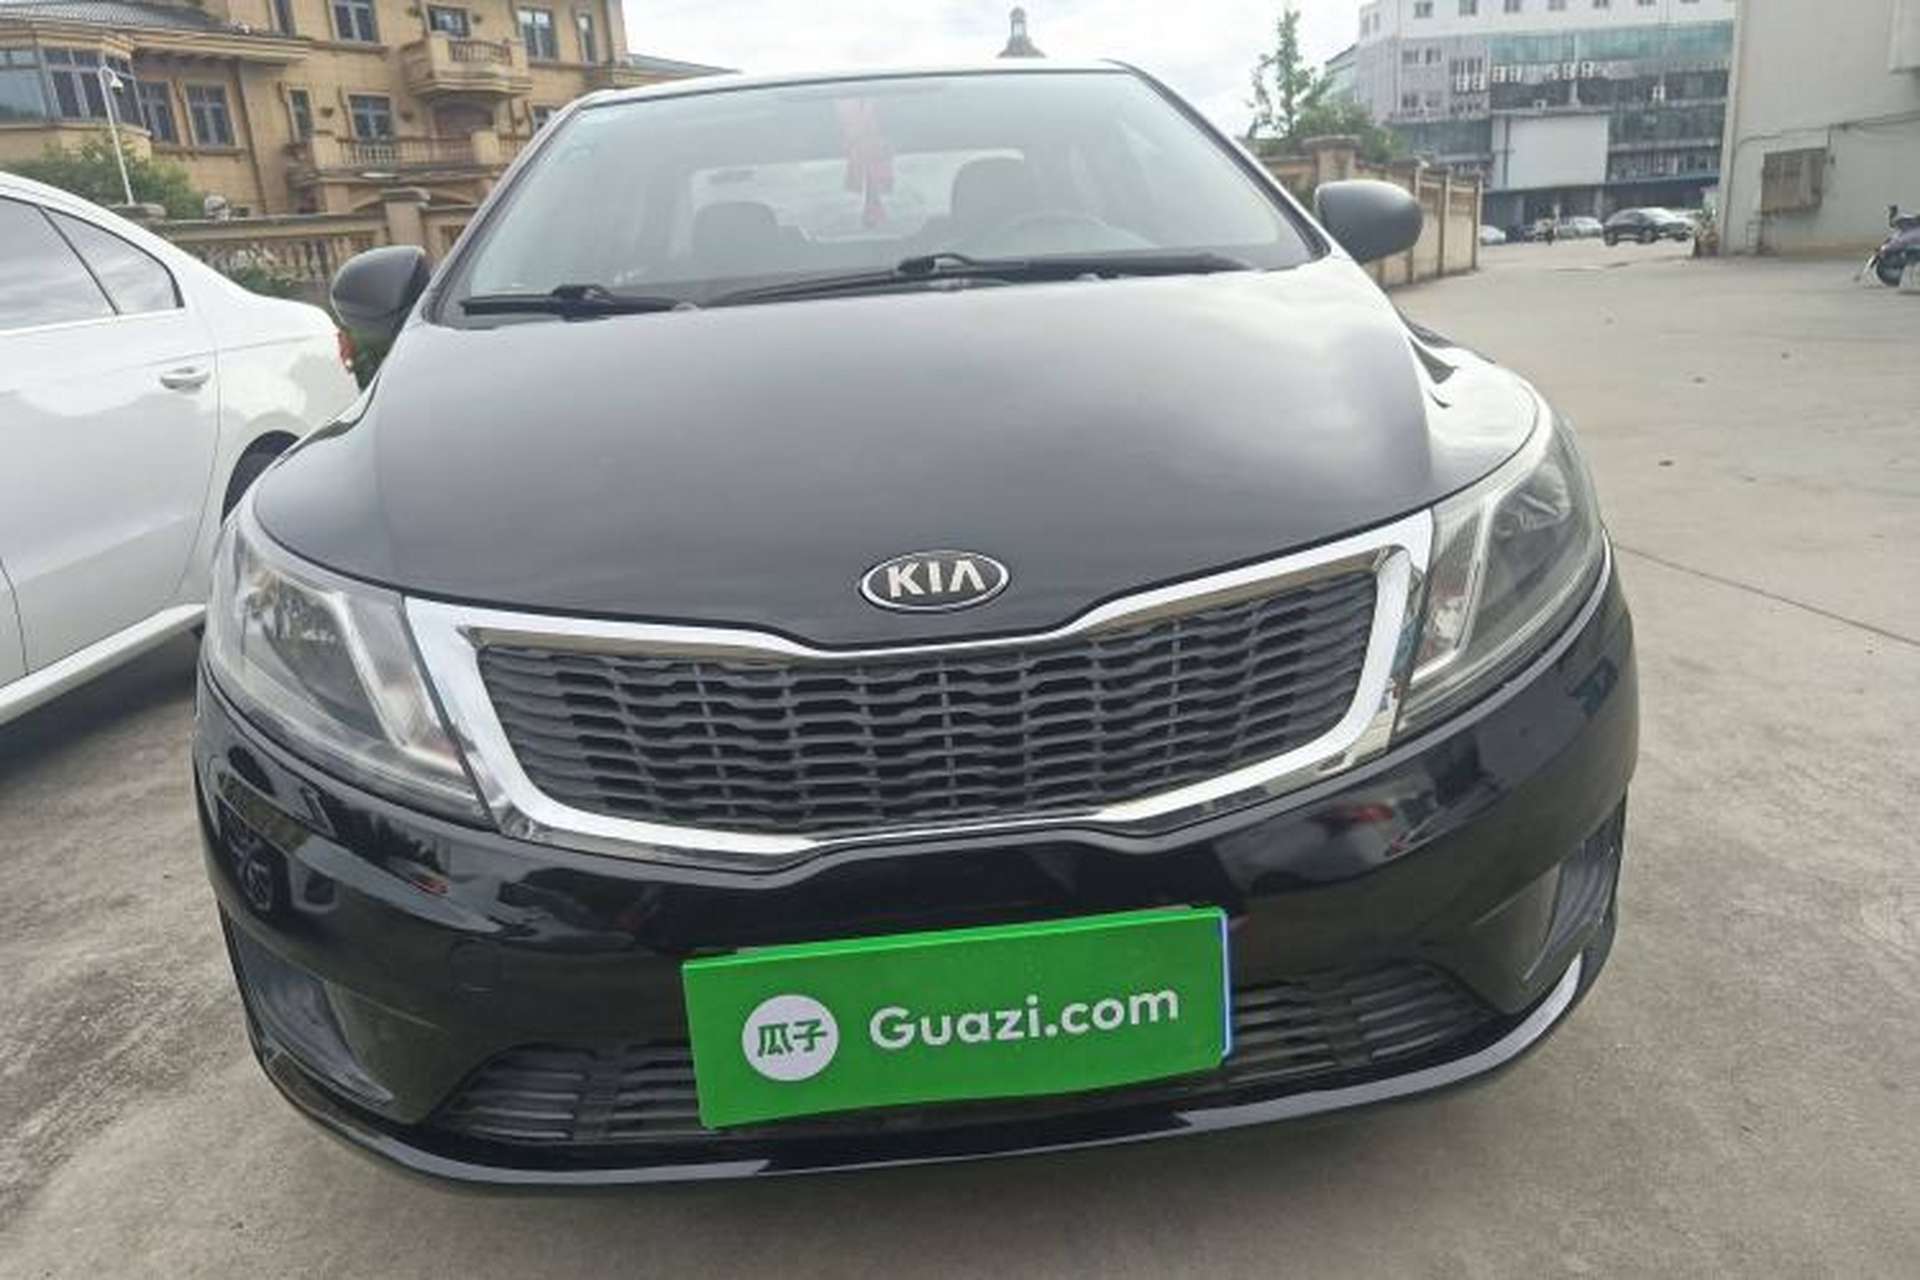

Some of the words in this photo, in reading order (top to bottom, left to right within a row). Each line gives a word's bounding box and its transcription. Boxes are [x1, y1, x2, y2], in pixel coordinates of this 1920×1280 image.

[887, 560, 986, 598] KIA
[869, 987, 1178, 1049] Guazi.com
[757, 1019, 827, 1058] 瓜子
